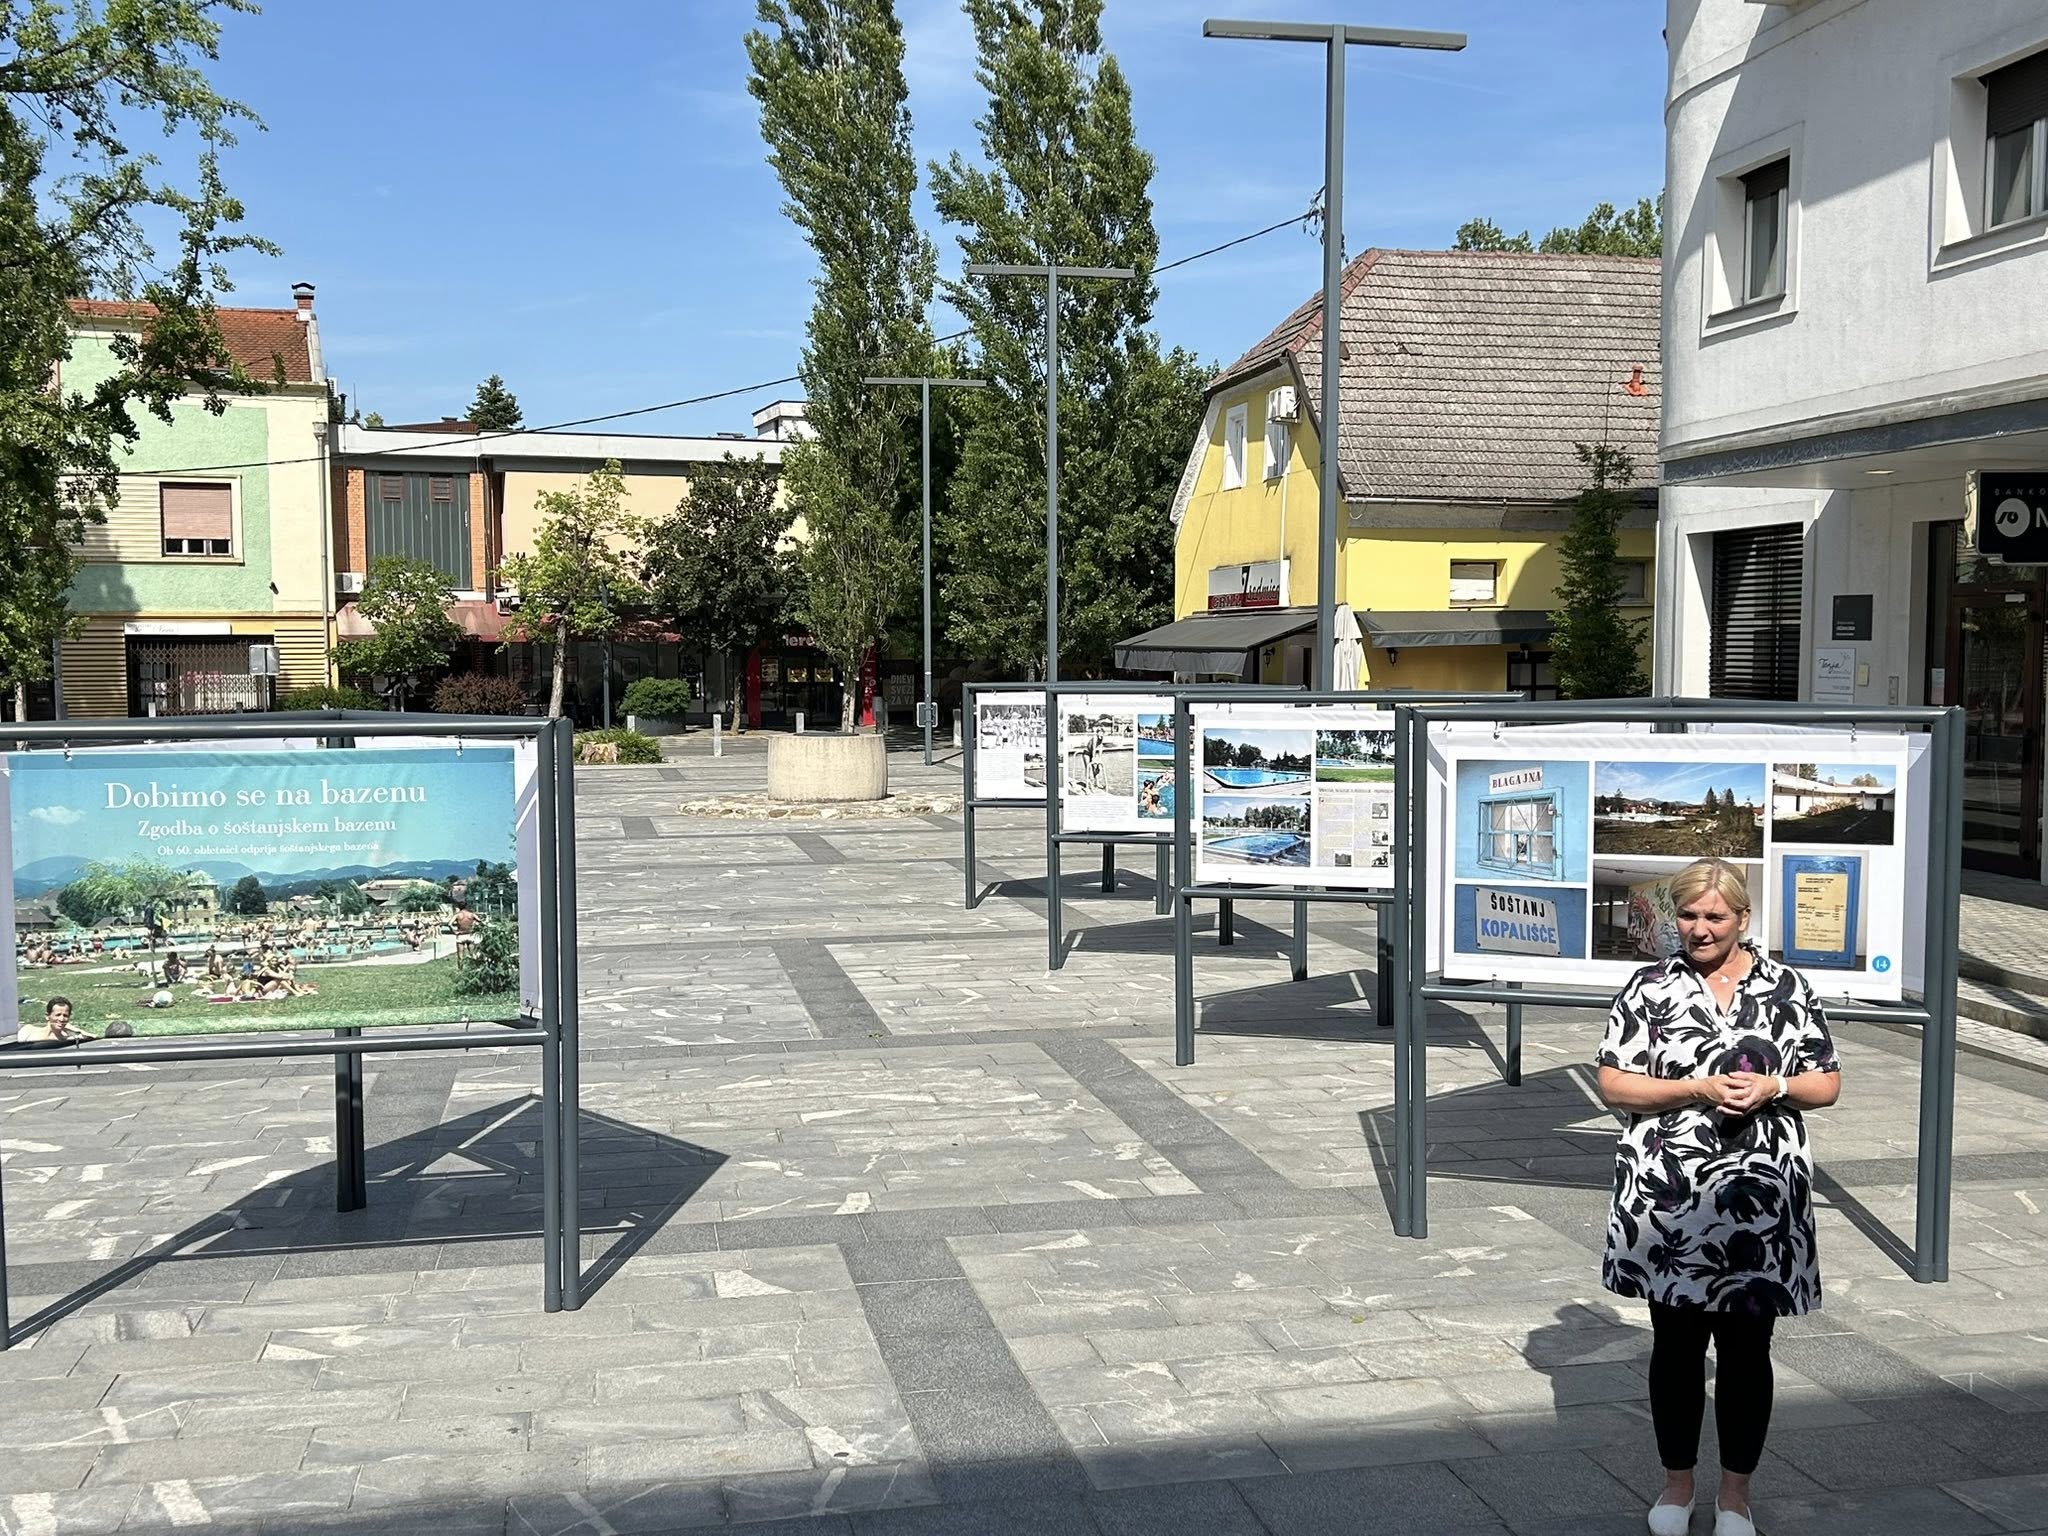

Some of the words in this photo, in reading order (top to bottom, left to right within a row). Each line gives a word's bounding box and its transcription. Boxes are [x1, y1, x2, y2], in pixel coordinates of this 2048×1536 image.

[1994, 488, 2047, 496] BANKO
[1492, 771, 1542, 789] BLAGAJNA
[104, 781, 227, 809] Dobimo
[236, 789, 266, 806] se
[276, 787, 312, 806] na
[320, 778, 427, 805] bazenu
[138, 819, 203, 841] Zgodba
[208, 824, 219, 836] o
[223, 817, 329, 838] šoštanjskem
[335, 816, 397, 832] bazenu
[157, 845, 174, 856] Ob
[194, 843, 238, 856] obletnici
[1491, 892, 1545, 918] ŠOŠTANJ
[1481, 918, 1557, 944] KOPALIŠČE
[1875, 958, 1888, 969] 14
